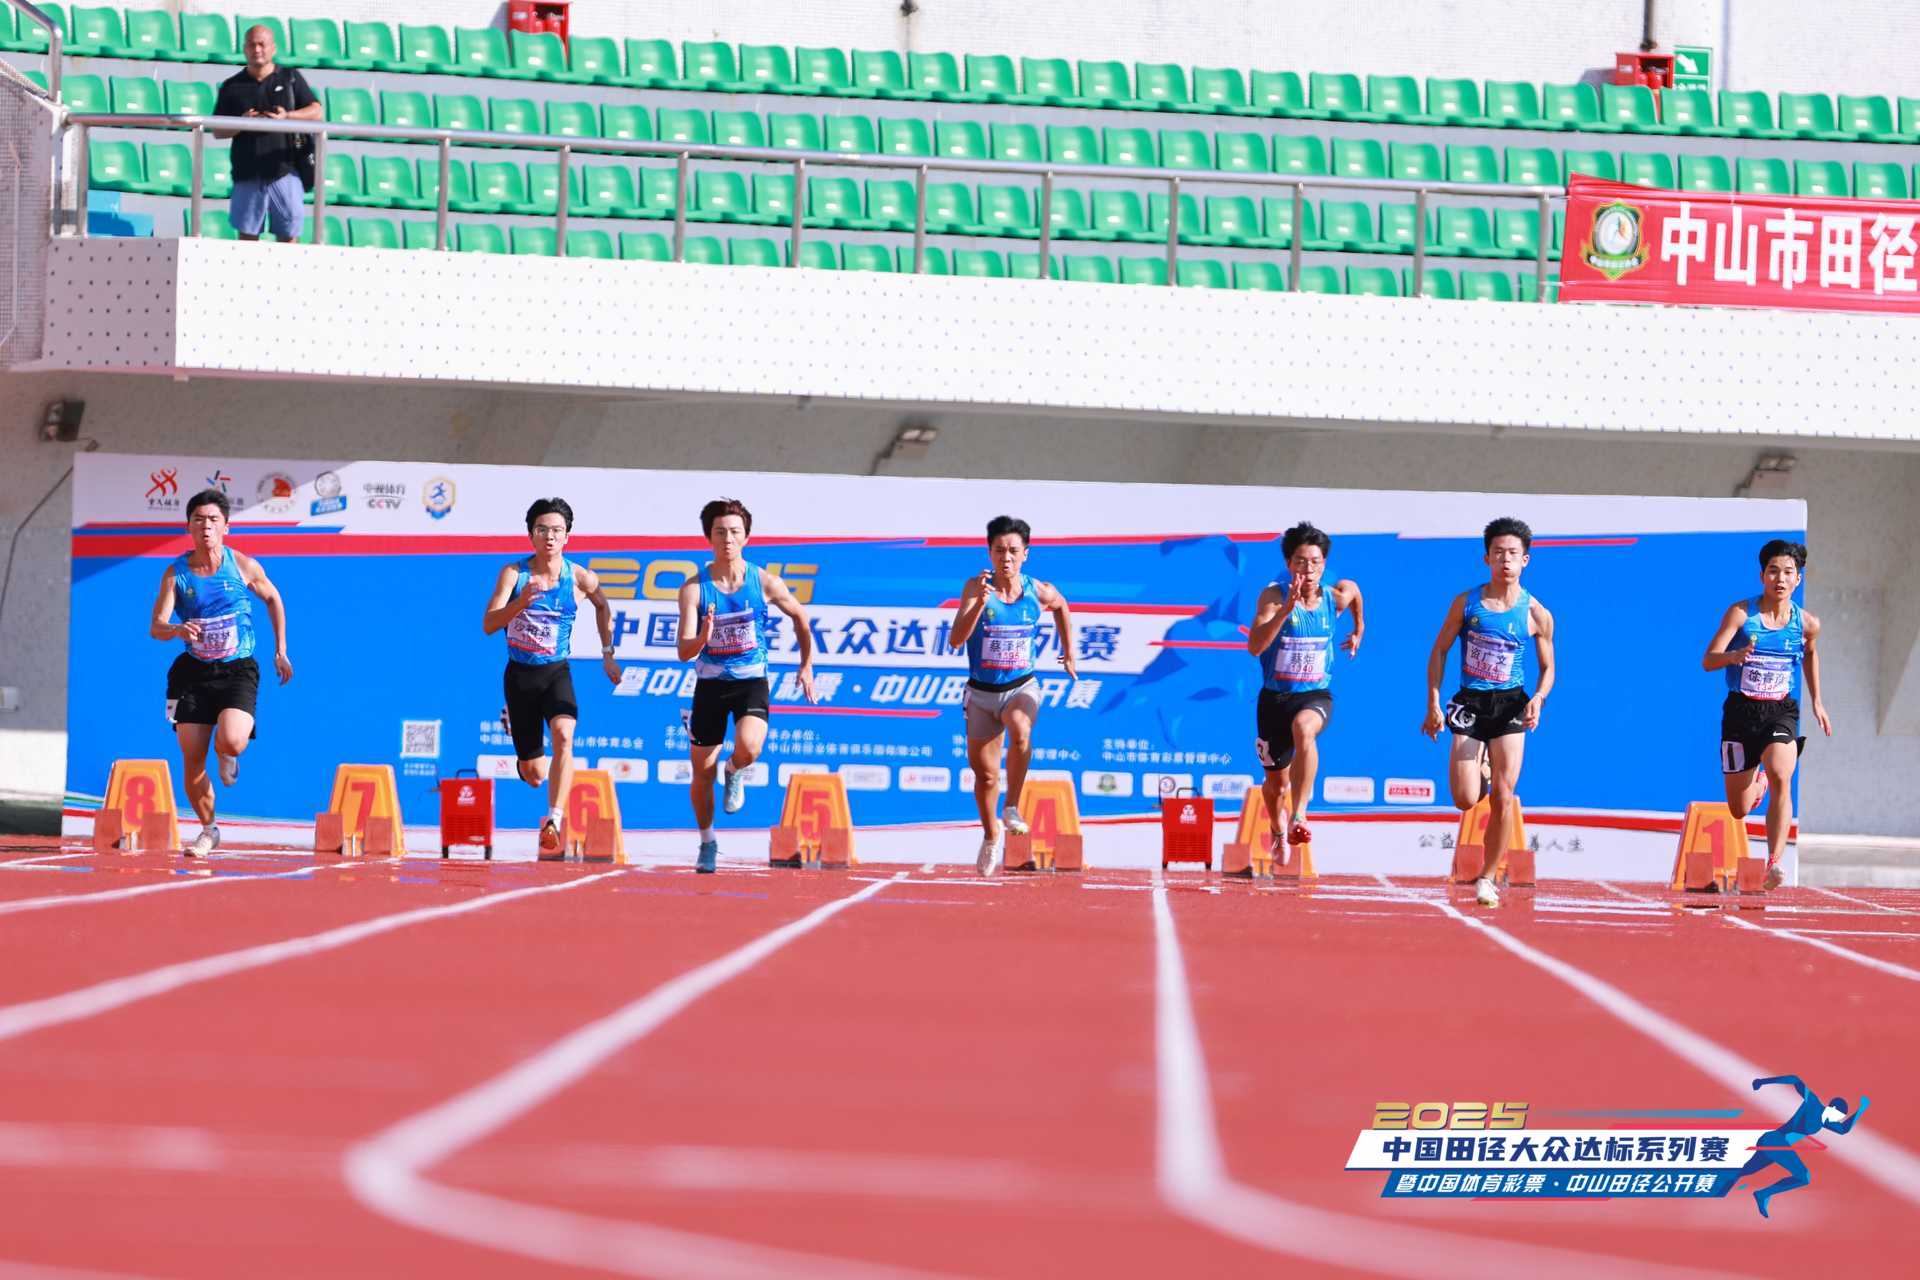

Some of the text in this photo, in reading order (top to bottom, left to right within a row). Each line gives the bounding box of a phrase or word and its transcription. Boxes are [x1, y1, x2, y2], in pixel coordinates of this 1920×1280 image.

[1660, 201, 1920, 295] 中山市田径
[367, 499, 402, 509] CCTV
[587, 558, 819, 605] 205
[612, 610, 1121, 662] 中国大众达标列赛
[124, 775, 156, 827] 8
[350, 781, 377, 833] 7
[570, 783, 600, 834] 6
[800, 790, 832, 840] 5
[1030, 797, 1062, 850] 4
[1702, 818, 1726, 869] 1
